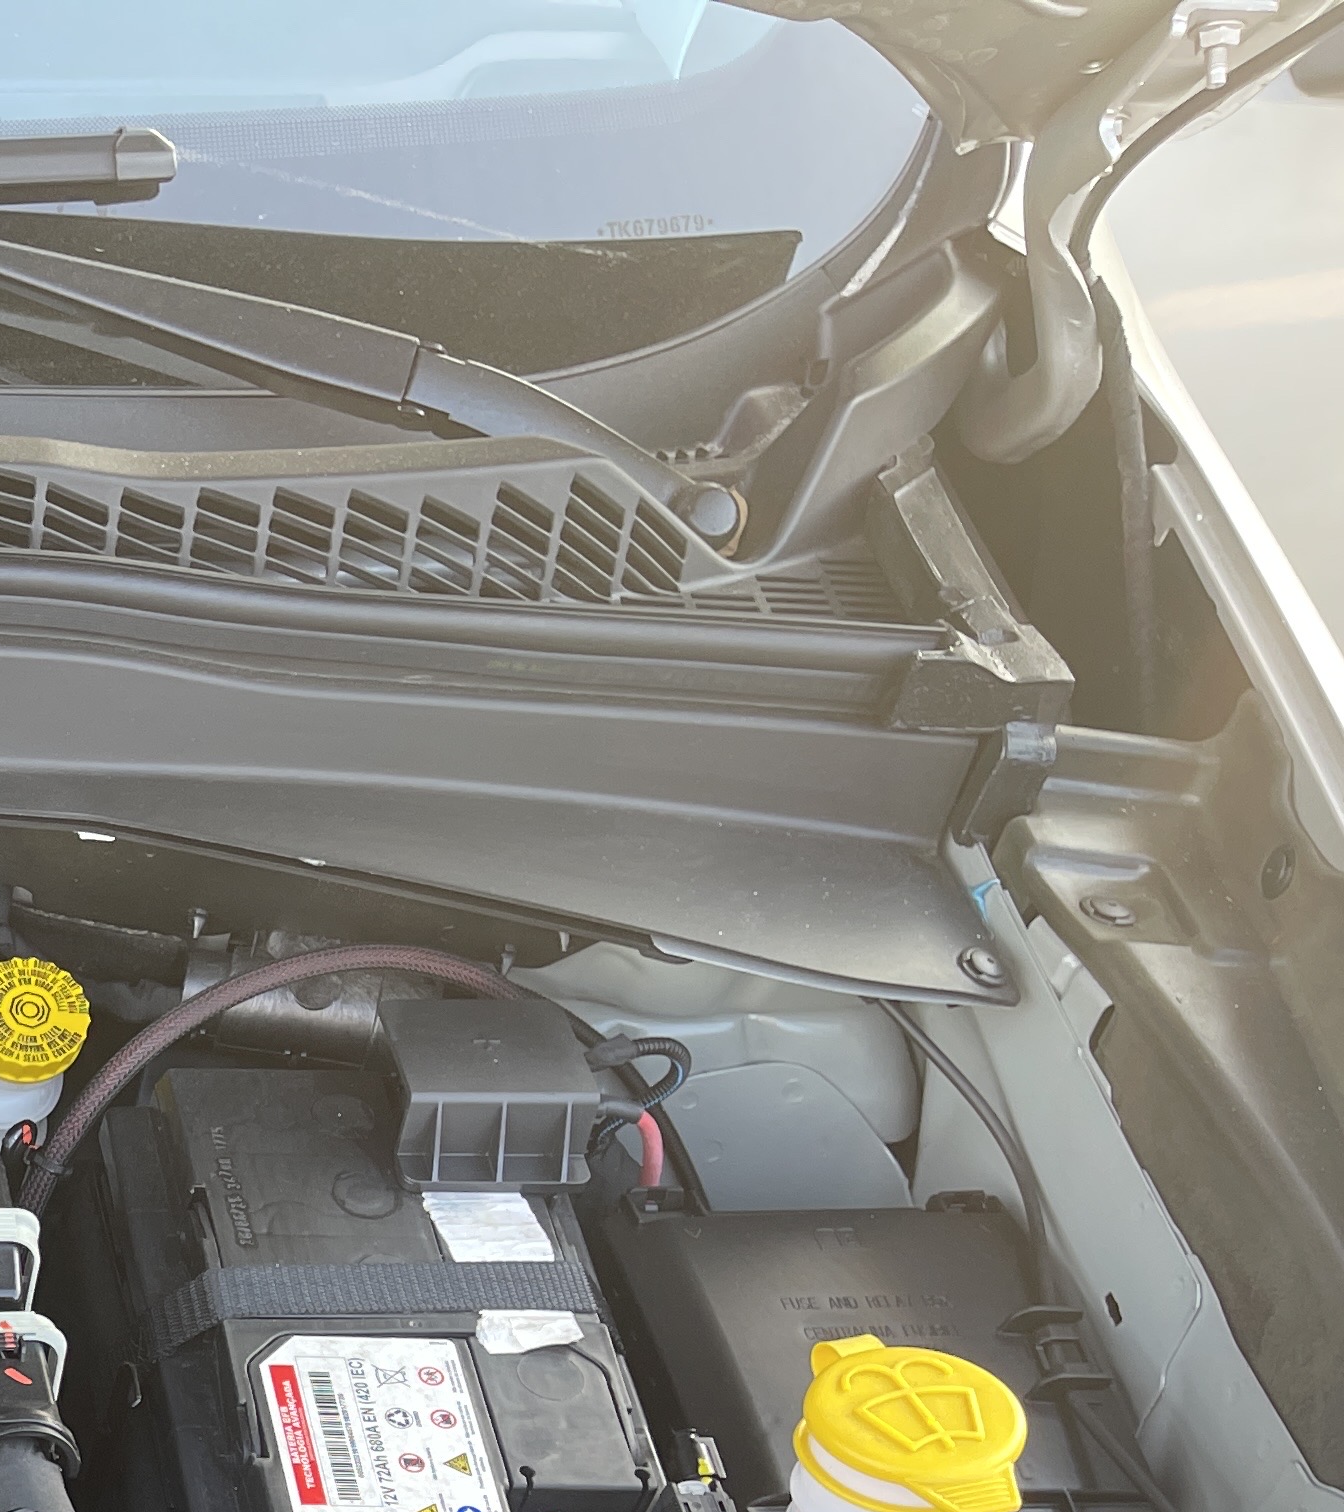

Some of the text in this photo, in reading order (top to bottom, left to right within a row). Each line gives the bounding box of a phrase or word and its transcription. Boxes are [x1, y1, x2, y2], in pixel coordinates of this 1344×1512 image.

[780, 1297, 820, 1311] FUSE
[829, 1296, 859, 1310] AND
[348, 1357, 366, 1380] IEC)
[282, 1380, 301, 1428] AVANÇADA
[354, 1382, 376, 1404] (420
[362, 1407, 377, 1423] EN
[283, 1424, 299, 1464] BATERIA
[367, 1425, 384, 1452] 680A
[297, 1428, 315, 1489] TECNOLOGIA
[373, 1454, 392, 1483] 72Ah
[380, 1485, 399, 1506] 12V
